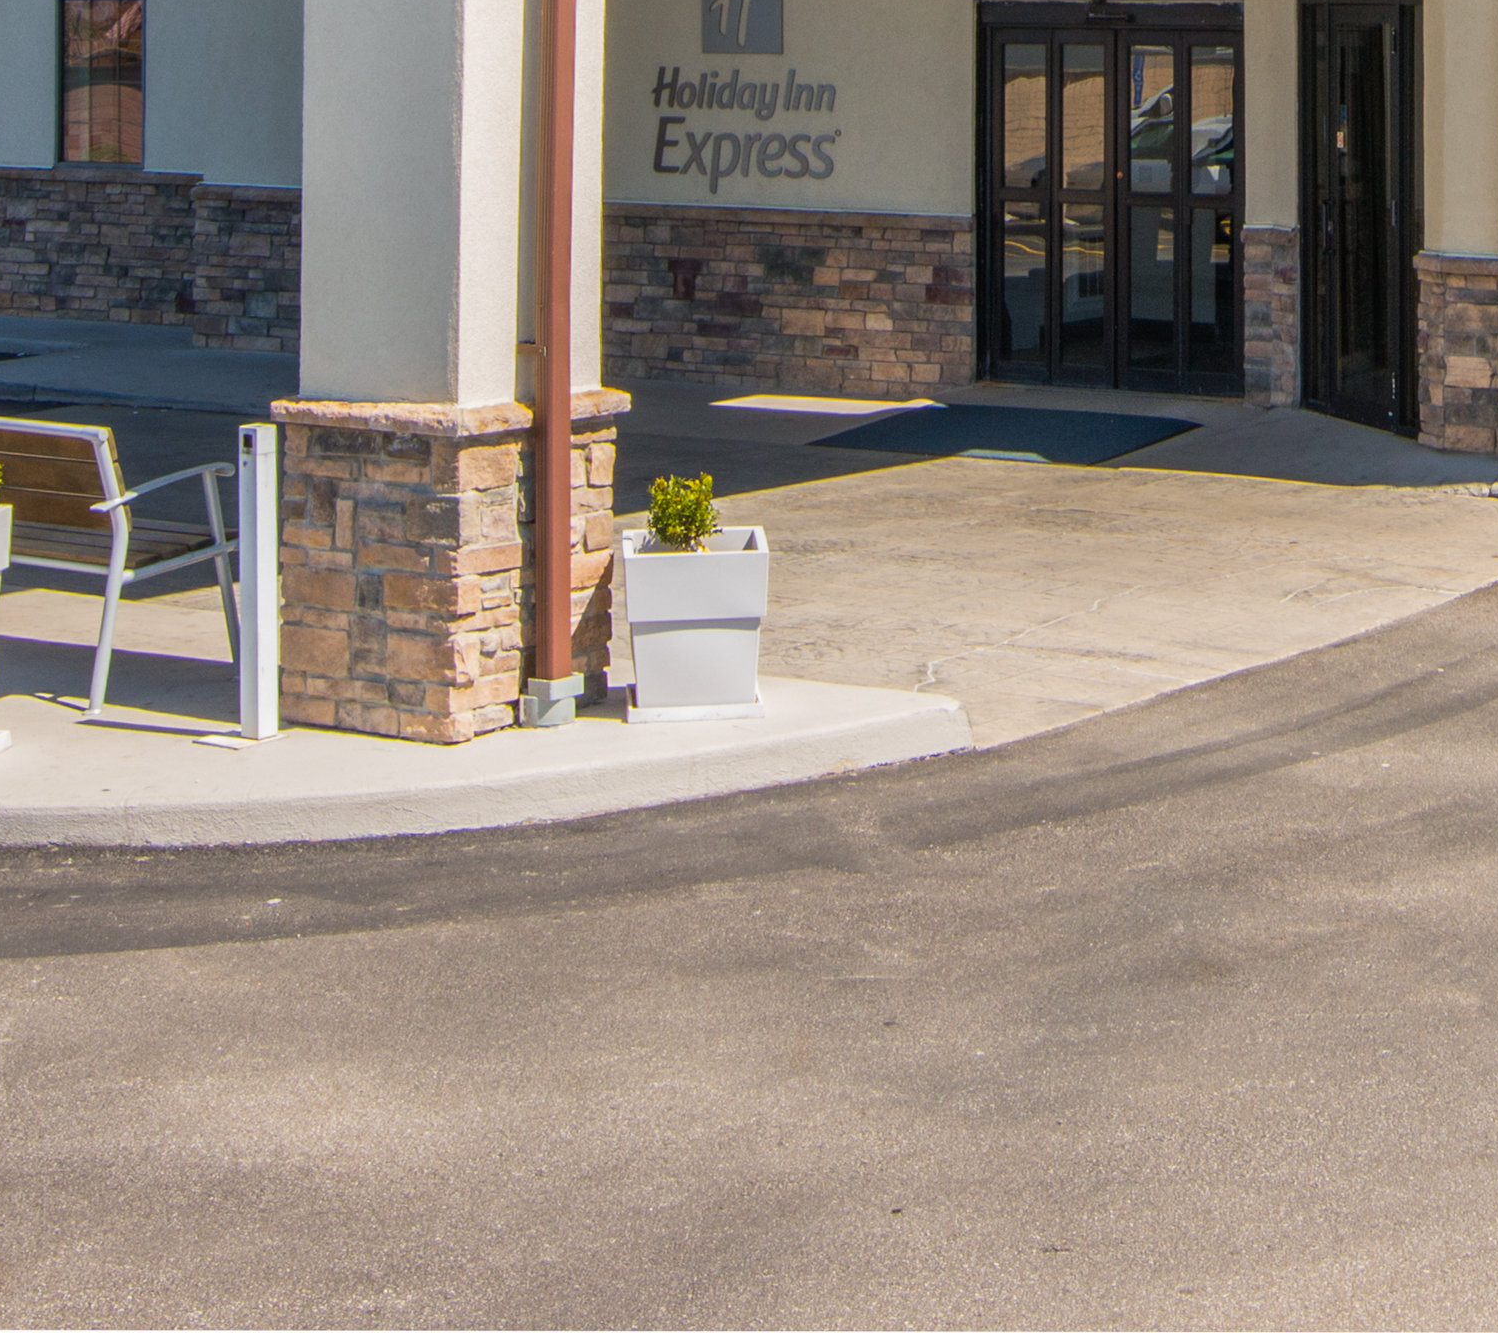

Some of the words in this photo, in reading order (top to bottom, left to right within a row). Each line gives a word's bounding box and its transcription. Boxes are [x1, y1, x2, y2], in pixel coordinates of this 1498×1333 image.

[652, 65, 779, 121] Holiday
[783, 68, 837, 113] Inn
[653, 115, 837, 195] Express
